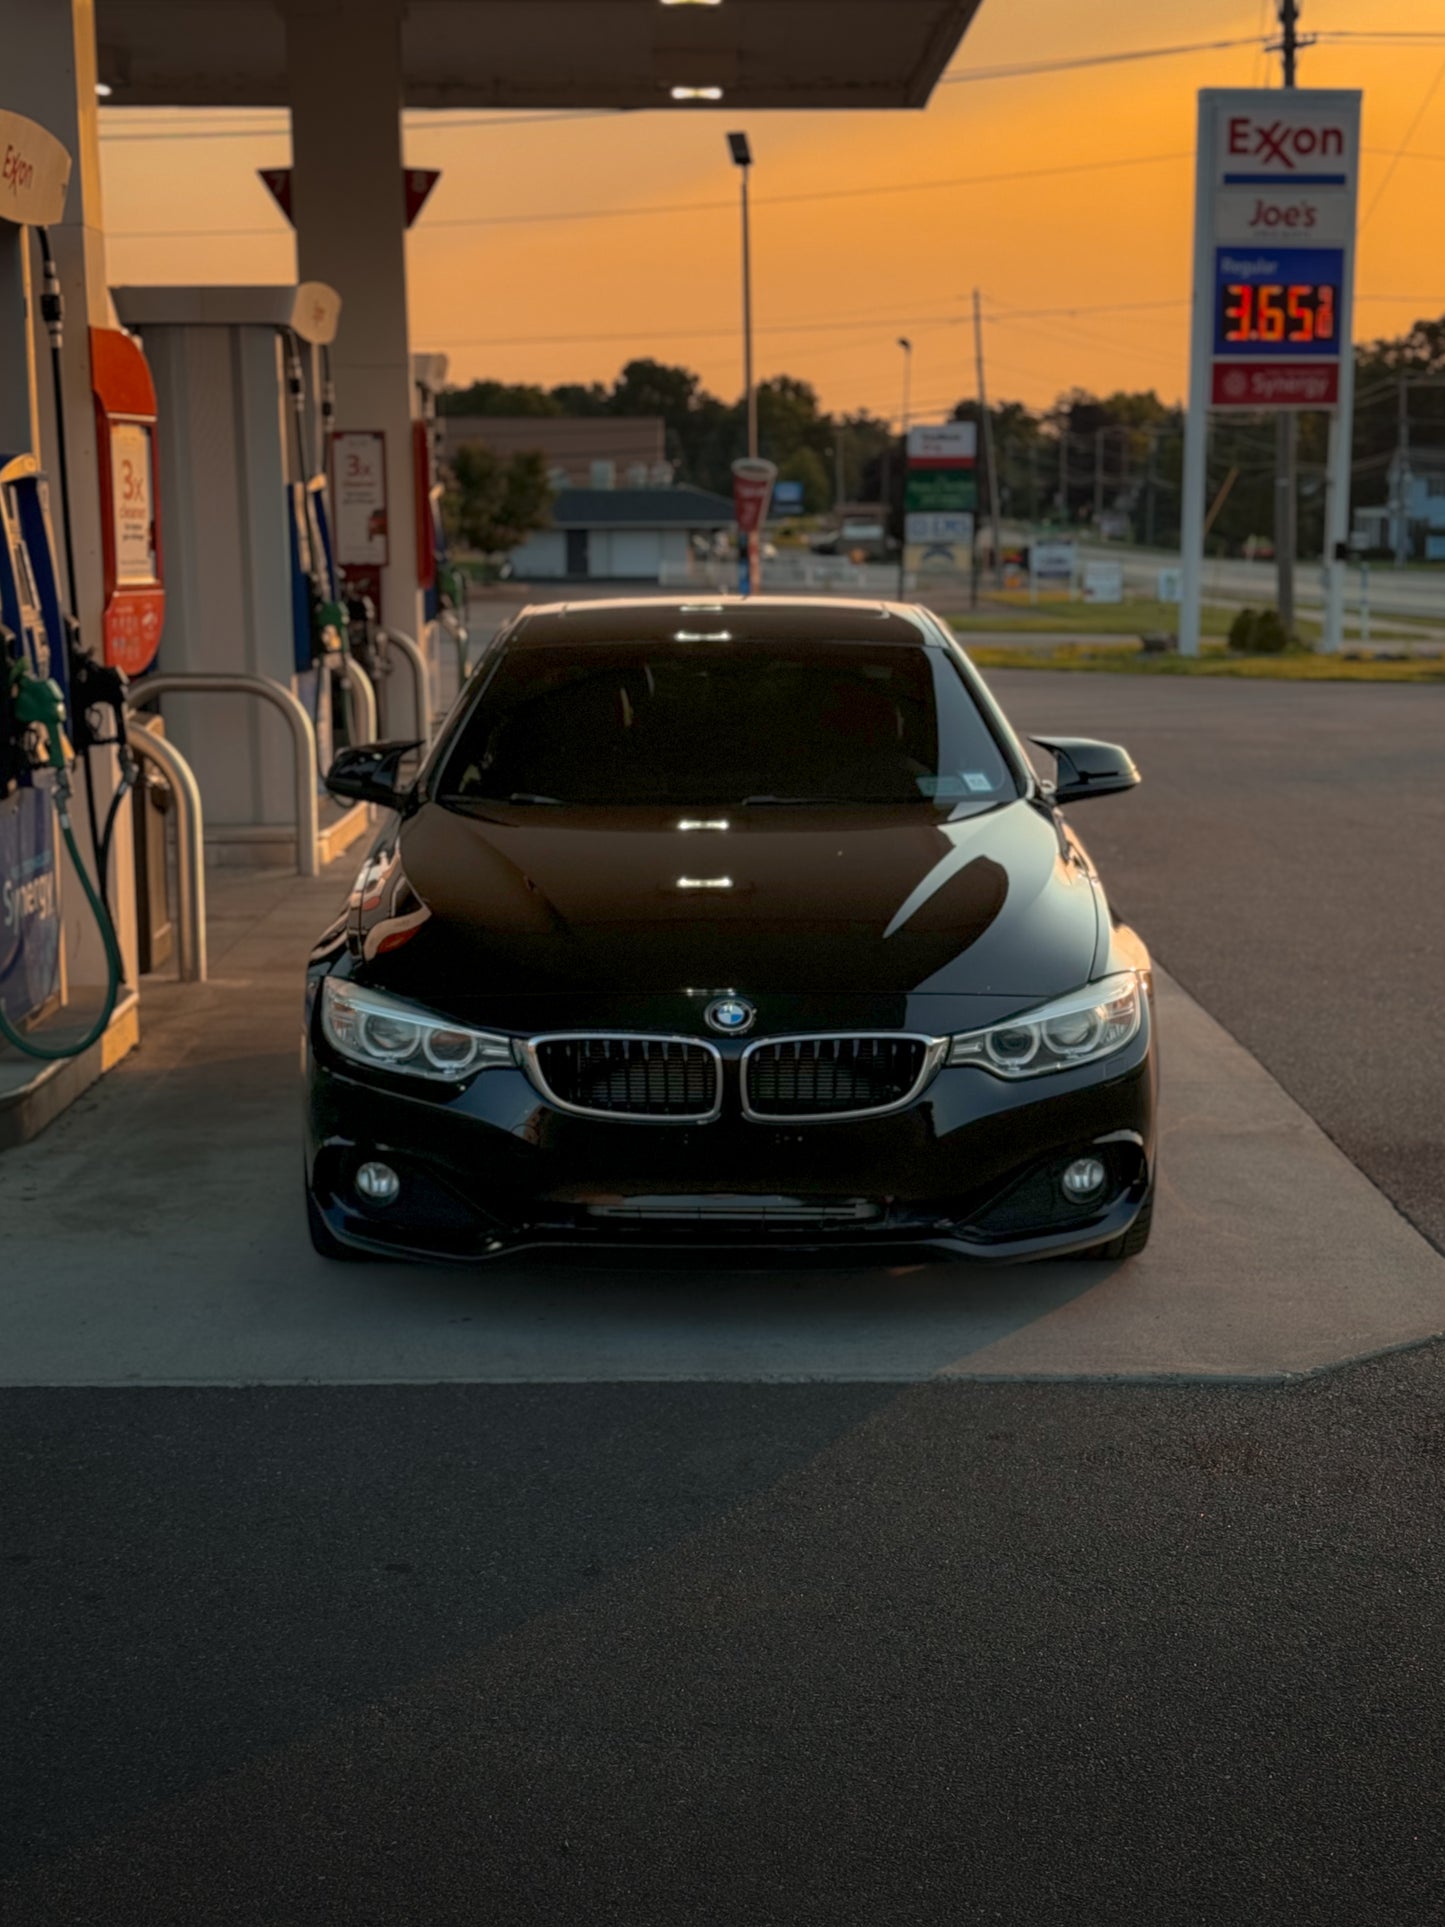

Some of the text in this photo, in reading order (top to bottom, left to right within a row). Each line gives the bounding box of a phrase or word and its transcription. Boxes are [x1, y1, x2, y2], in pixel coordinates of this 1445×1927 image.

[1229, 116, 1344, 169] Exxon
[2, 143, 33, 196] Exxon
[1249, 199, 1317, 228] Joe's
[1220, 256, 1279, 278] Regular
[1251, 371, 1330, 398] Synergy
